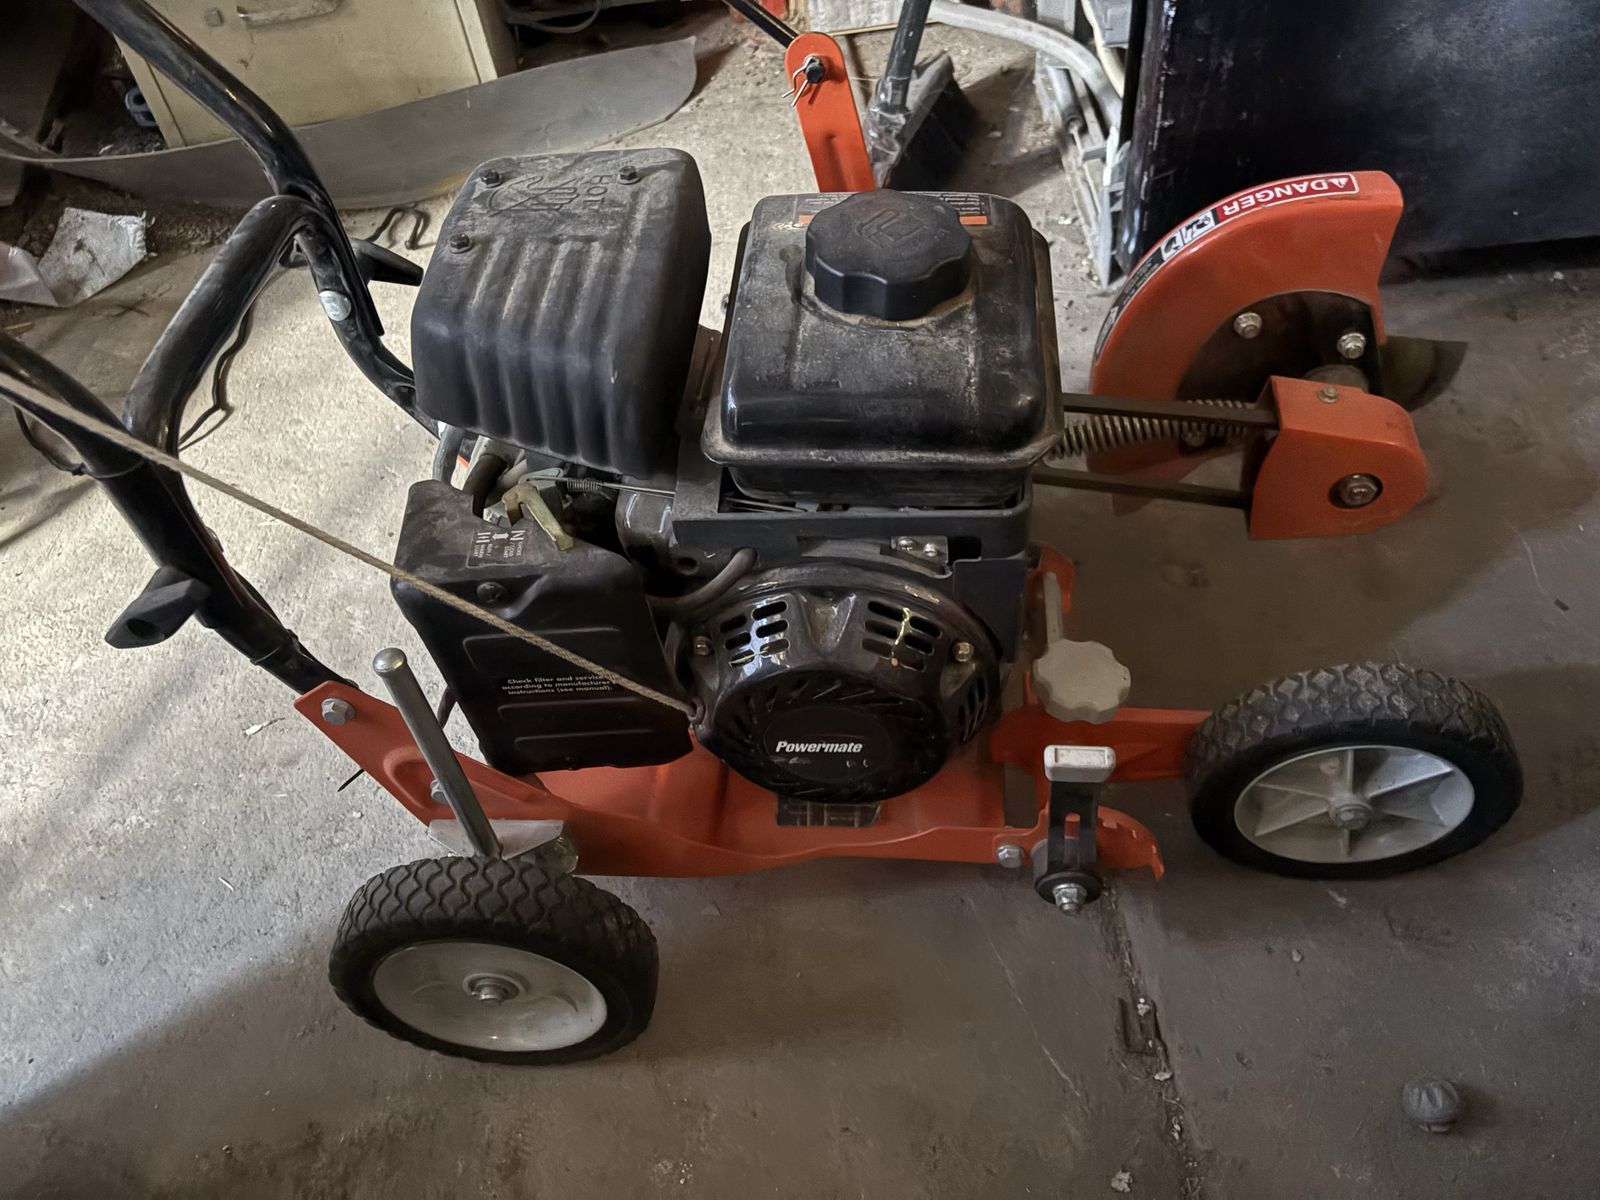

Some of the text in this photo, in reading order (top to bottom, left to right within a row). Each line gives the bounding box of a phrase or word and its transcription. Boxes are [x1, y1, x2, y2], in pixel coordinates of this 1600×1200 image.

[583, 174, 613, 206] HOT
[1222, 178, 1329, 216] DANGER
[502, 682, 542, 691] according
[534, 676, 553, 684] filter
[775, 740, 863, 753] Powermate
